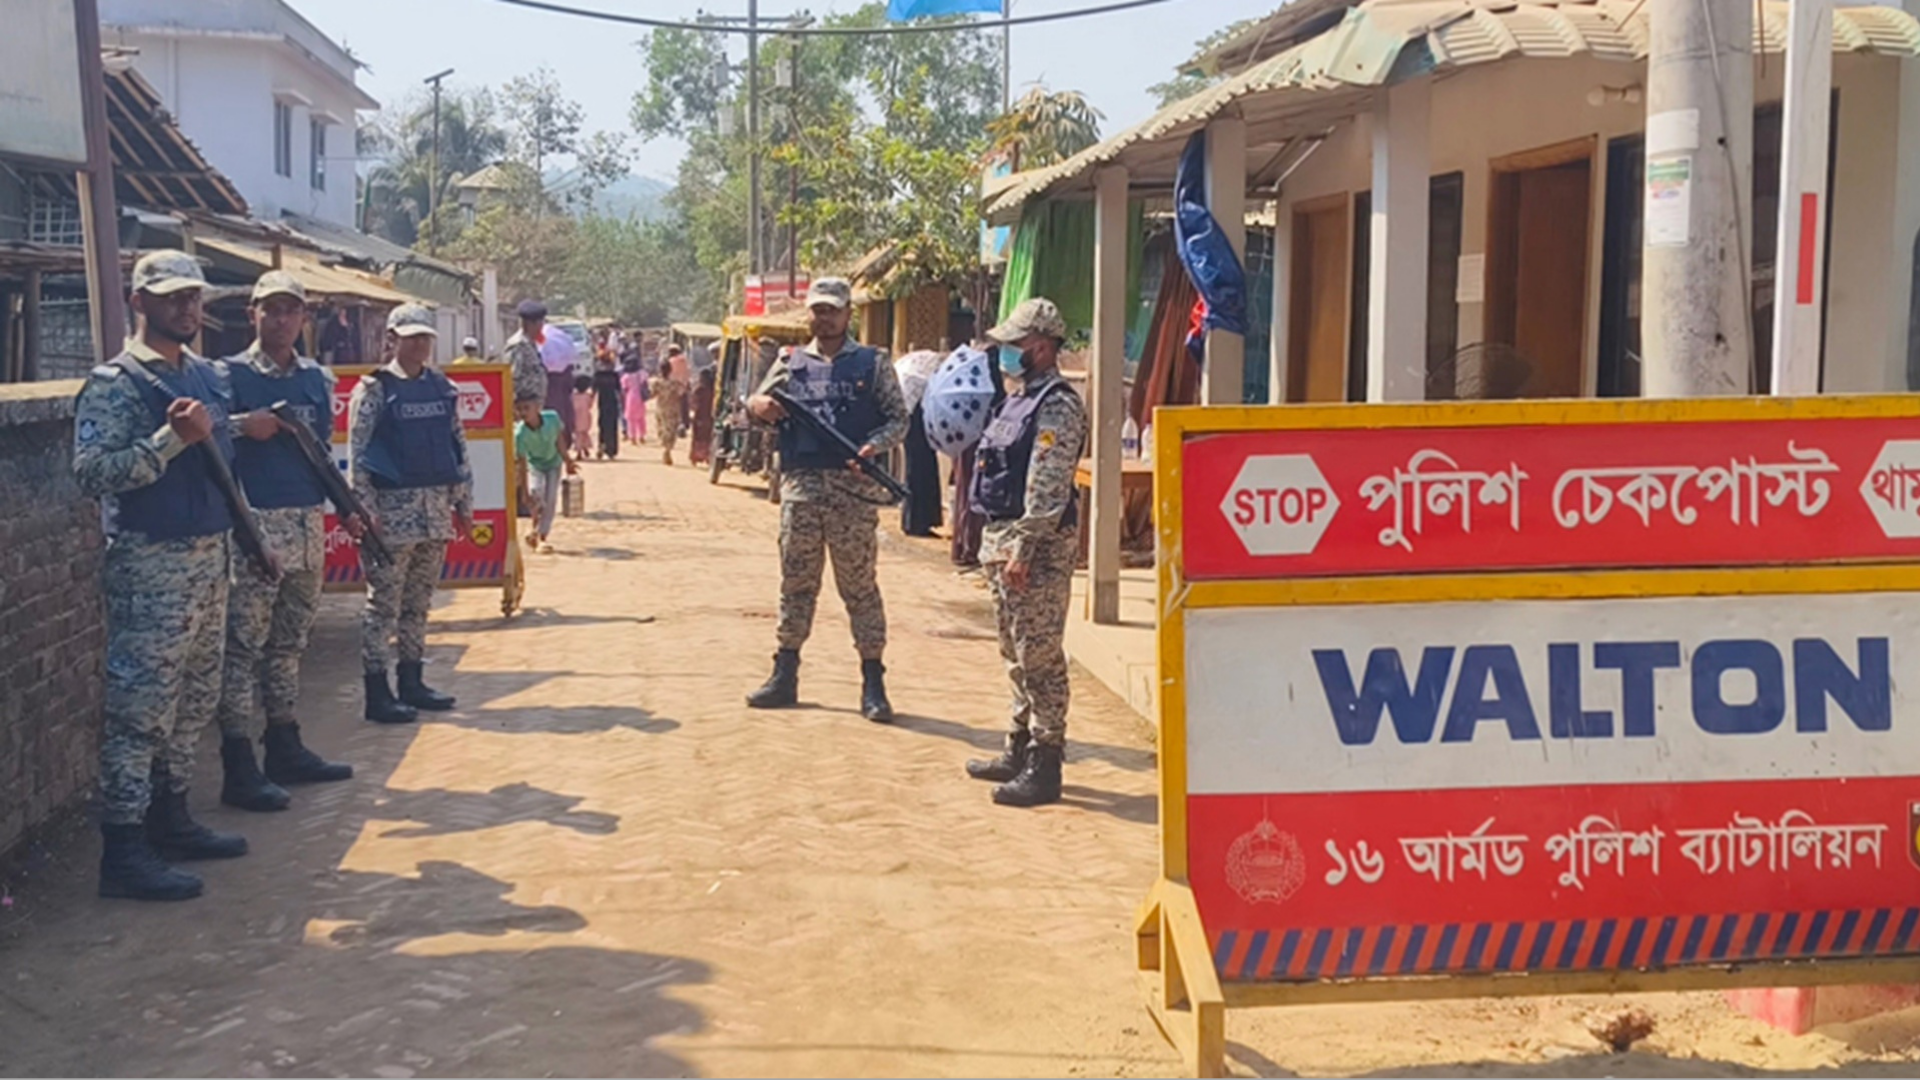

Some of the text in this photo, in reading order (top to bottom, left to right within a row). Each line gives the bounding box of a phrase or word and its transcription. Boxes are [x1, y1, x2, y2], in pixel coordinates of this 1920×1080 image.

[1233, 487, 1328, 527] STOP
[1358, 440, 1840, 552] পুলিশ চেকপোস্ট
[1311, 637, 1892, 746] WALTON
[1324, 809, 1889, 889] ১৬ আর্মড পুলিশ ব্যাটালিয়ন
